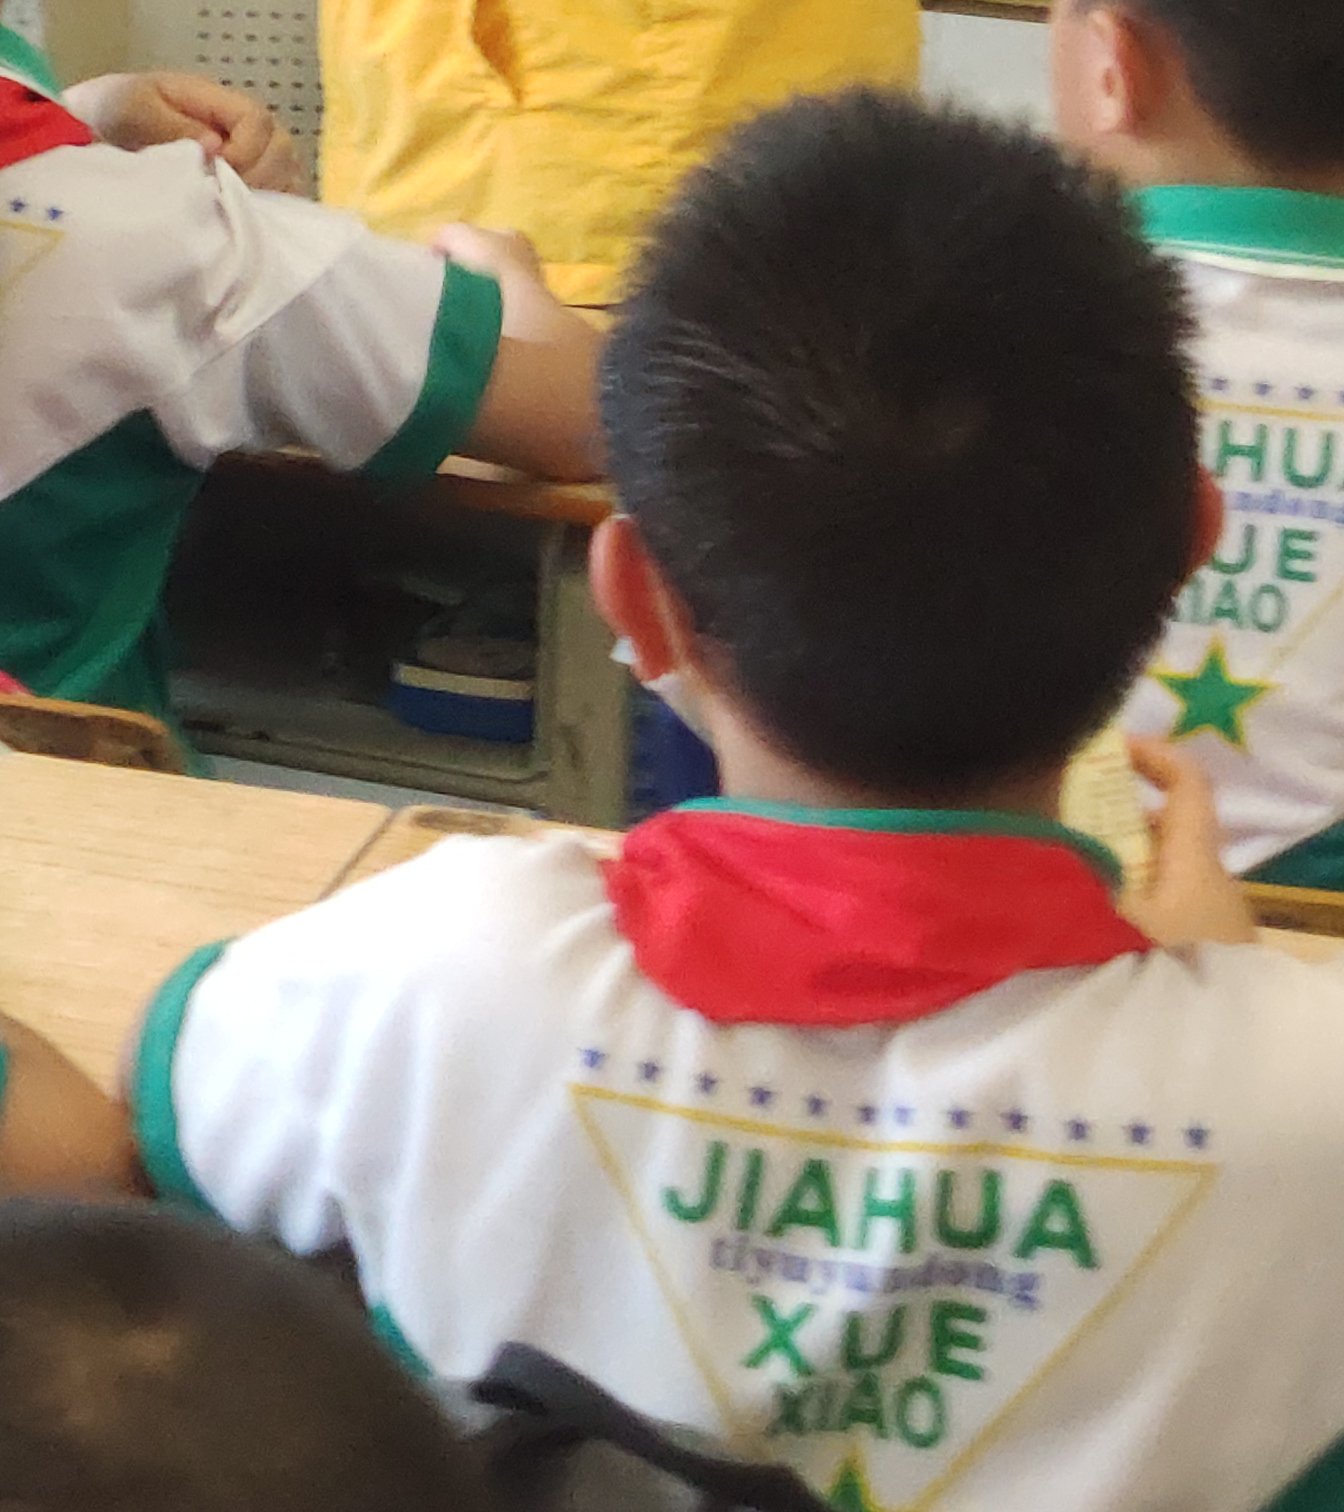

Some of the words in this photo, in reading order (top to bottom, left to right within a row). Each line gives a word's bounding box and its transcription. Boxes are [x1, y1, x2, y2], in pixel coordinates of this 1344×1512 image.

[662, 1139, 1102, 1270] JIAHUA
[743, 1294, 991, 1382] XUE
[768, 1371, 947, 1450] XIAO
